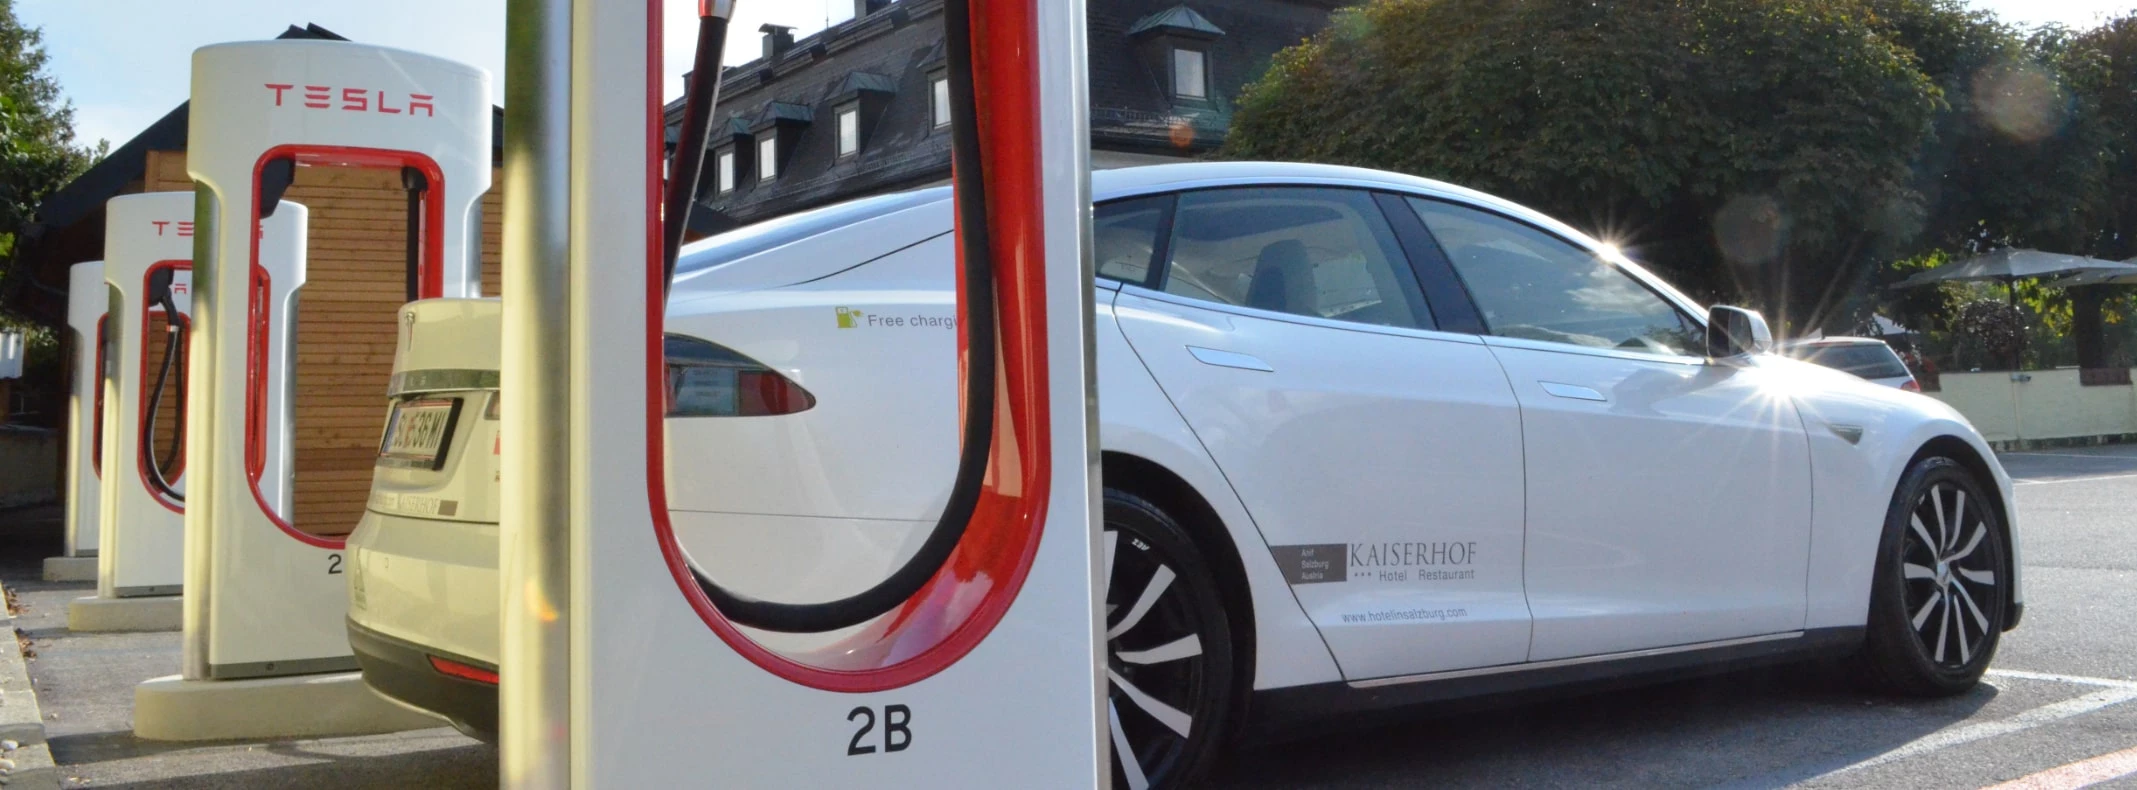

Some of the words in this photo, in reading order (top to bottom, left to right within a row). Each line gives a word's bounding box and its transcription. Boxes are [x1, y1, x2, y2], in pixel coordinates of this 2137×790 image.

[264, 83, 433, 117] TESLA
[867, 314, 904, 328] Free
[909, 314, 958, 330] chargi
[328, 553, 343, 575] 2
[1350, 542, 1477, 567] KAISERHOF
[1379, 571, 1408, 582] Hotel
[1418, 569, 1475, 581] Restaurant
[1341, 608, 1467, 623] www.hotelinsalzburg.com
[846, 703, 912, 756] 2B
